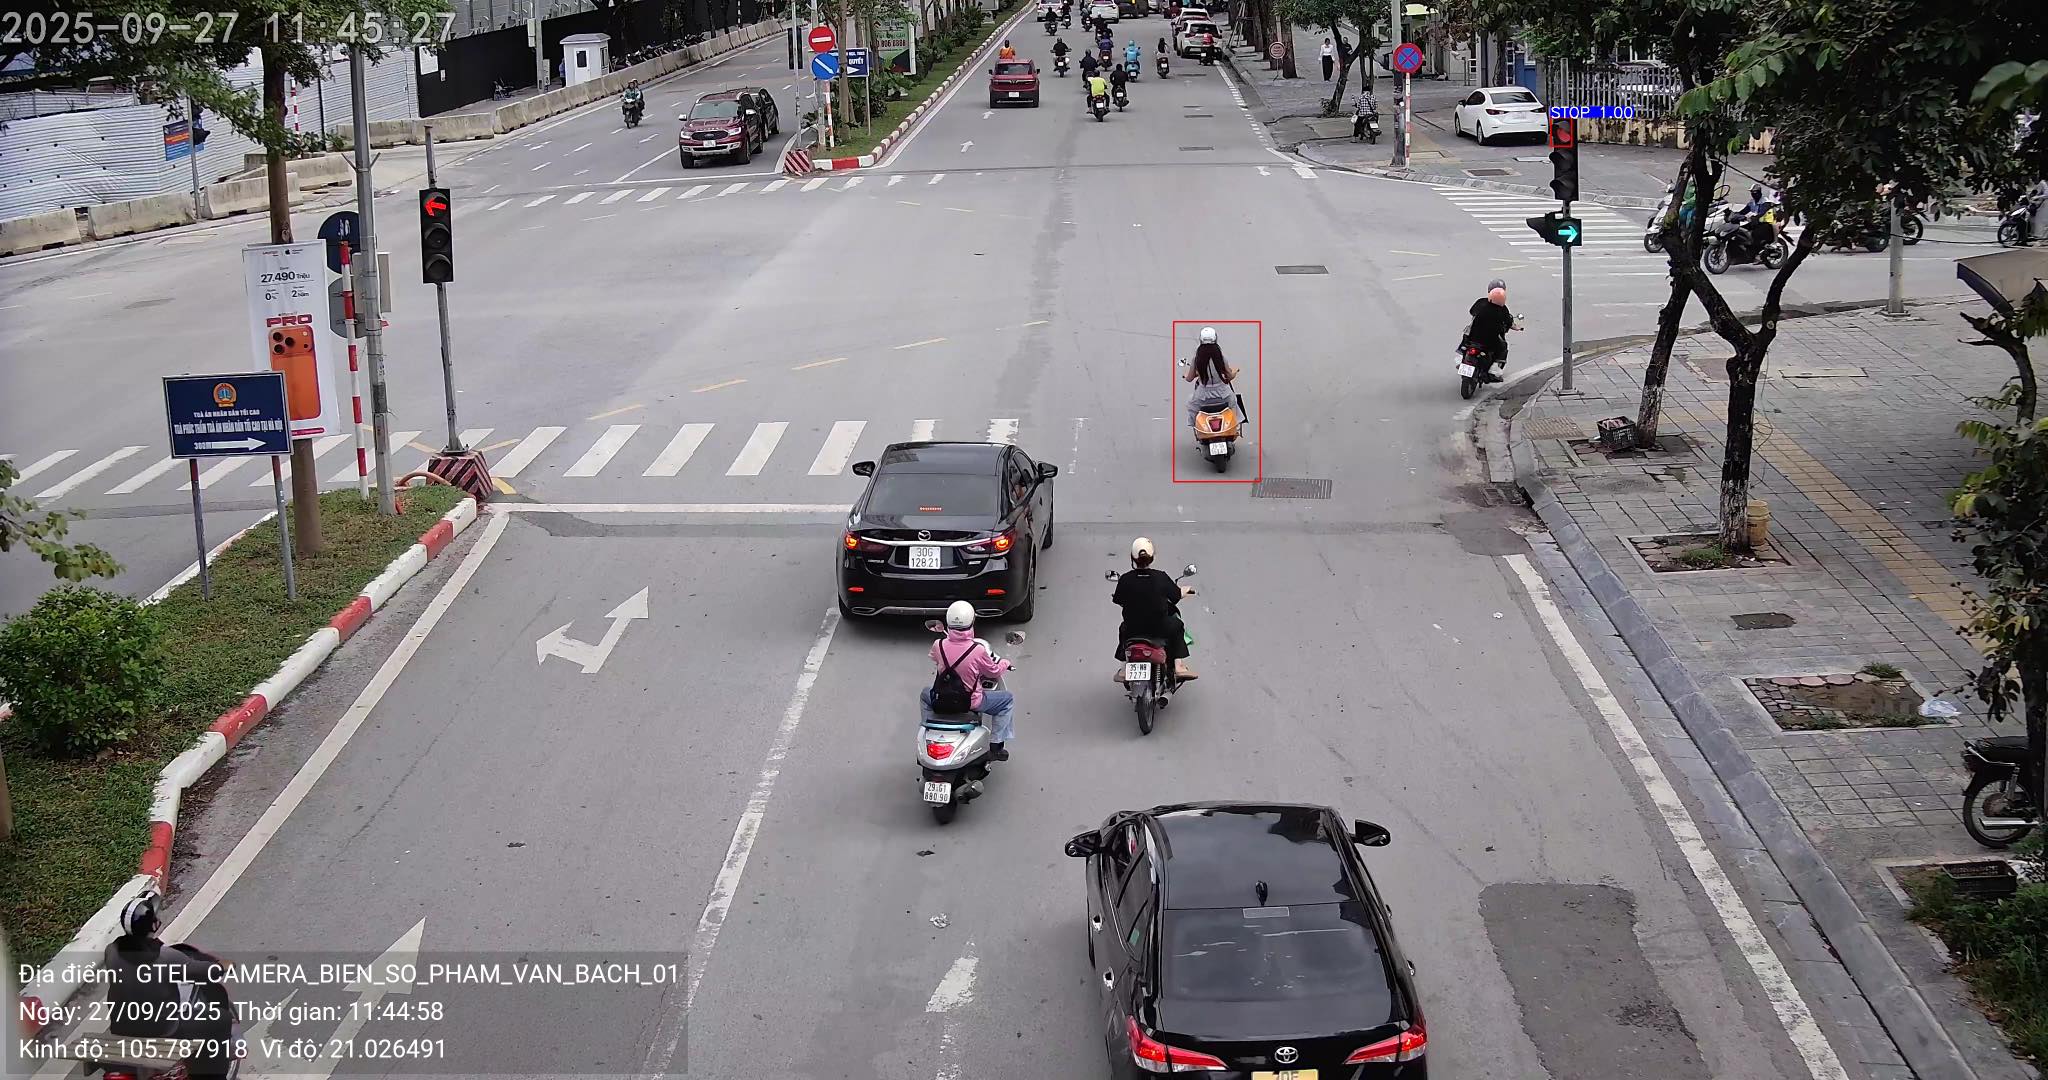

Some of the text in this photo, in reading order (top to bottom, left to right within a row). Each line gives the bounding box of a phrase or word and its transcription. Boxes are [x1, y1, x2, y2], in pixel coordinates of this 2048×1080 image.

[260, 271, 296, 283] 27.490
[266, 314, 312, 327] PRO
[917, 547, 934, 557] 30G
[911, 558, 939, 568] 128.21
